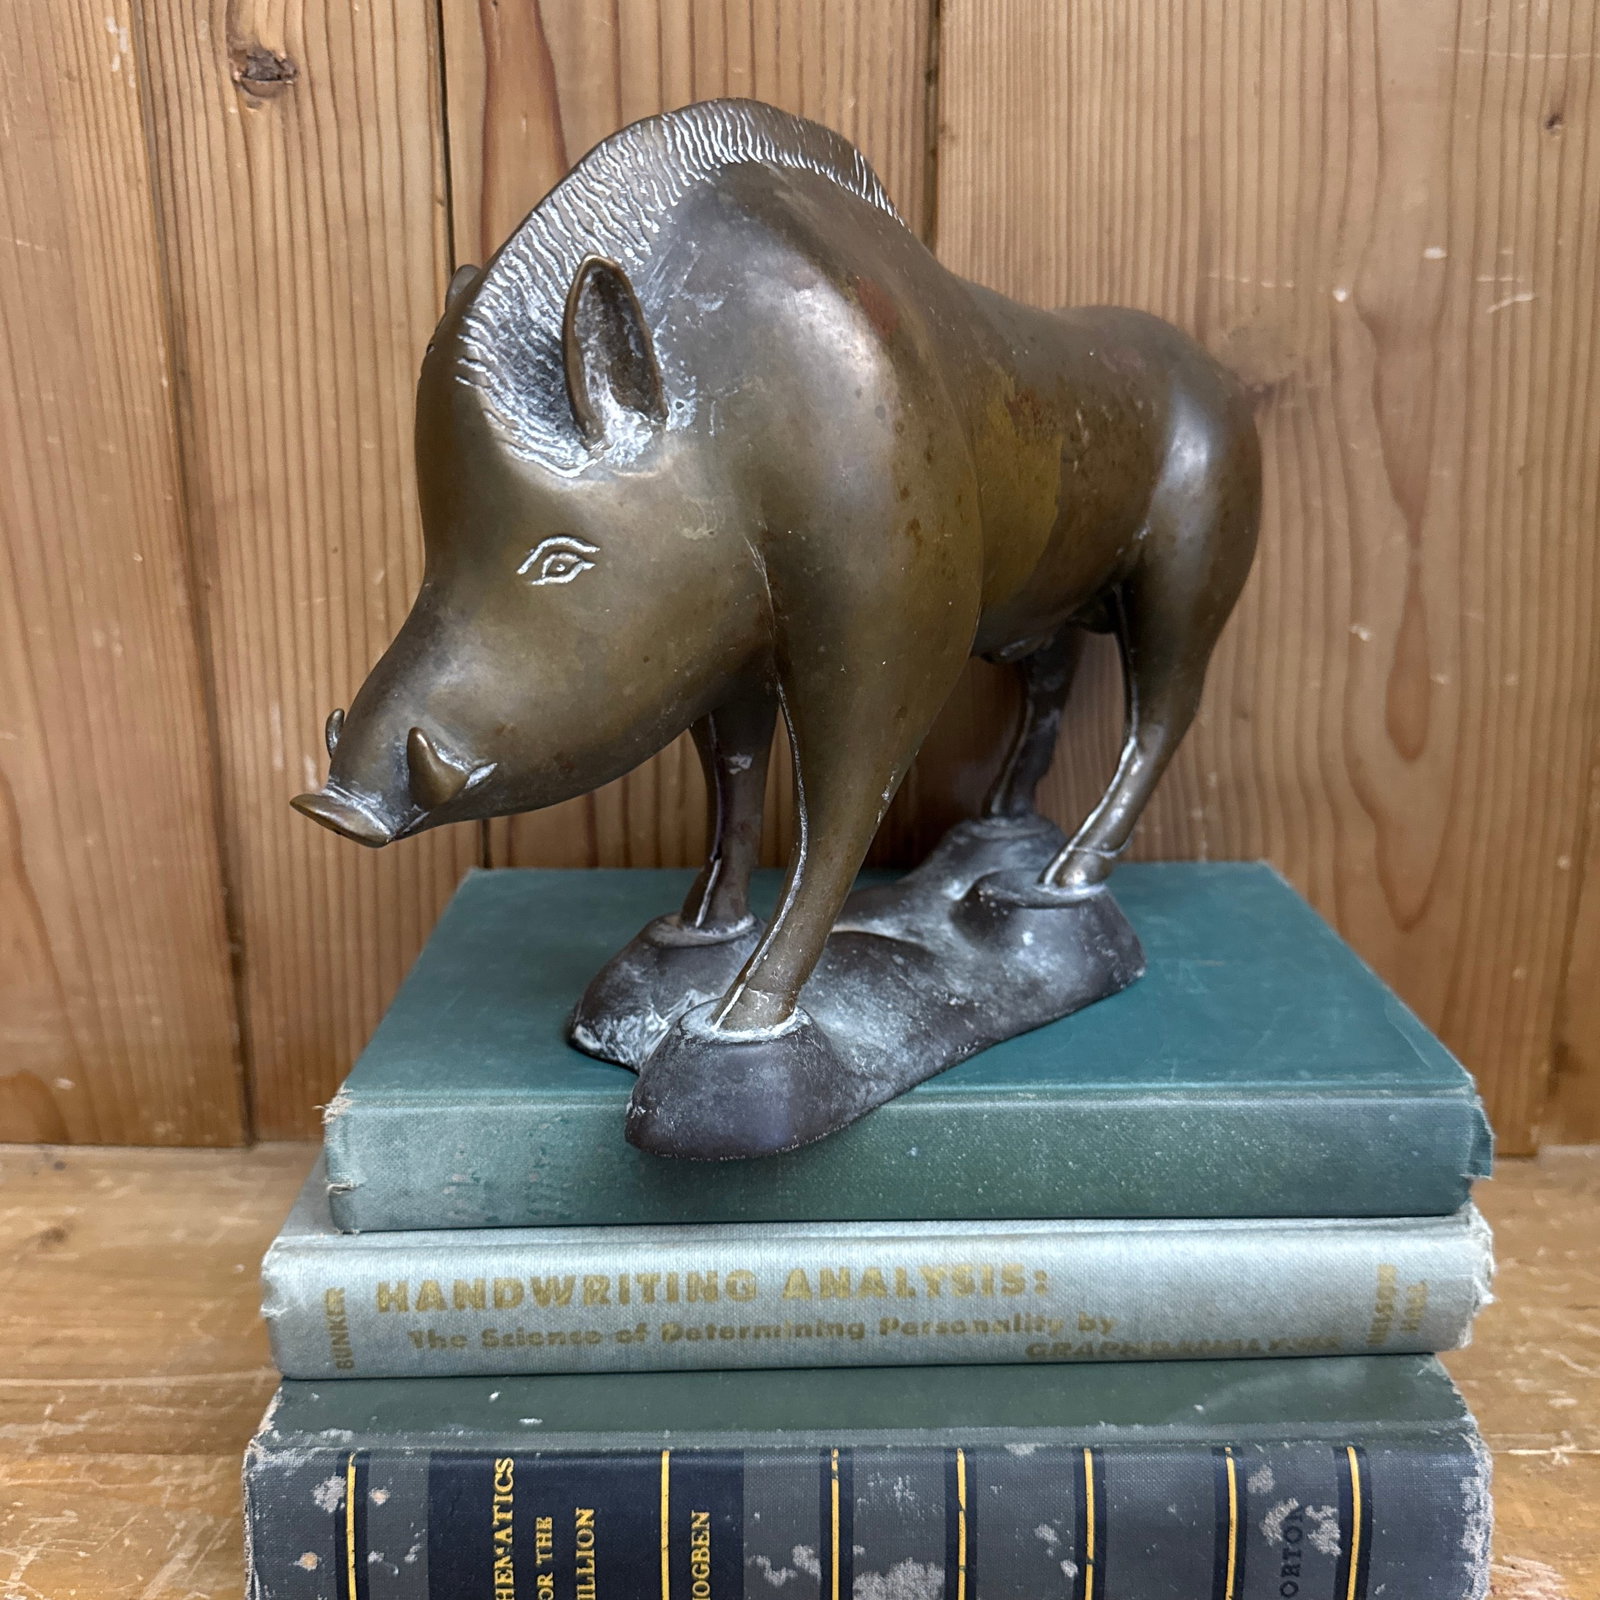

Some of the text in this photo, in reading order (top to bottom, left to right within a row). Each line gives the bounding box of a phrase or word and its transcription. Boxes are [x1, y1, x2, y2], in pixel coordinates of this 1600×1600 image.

[376, 1263, 1048, 1313] HANDWRITING ANALYSIS:
[408, 1311, 1117, 1348] The Science of Determining Personality by
[535, 1516, 553, 1565] THE
[691, 1510, 711, 1600] OGBEN
